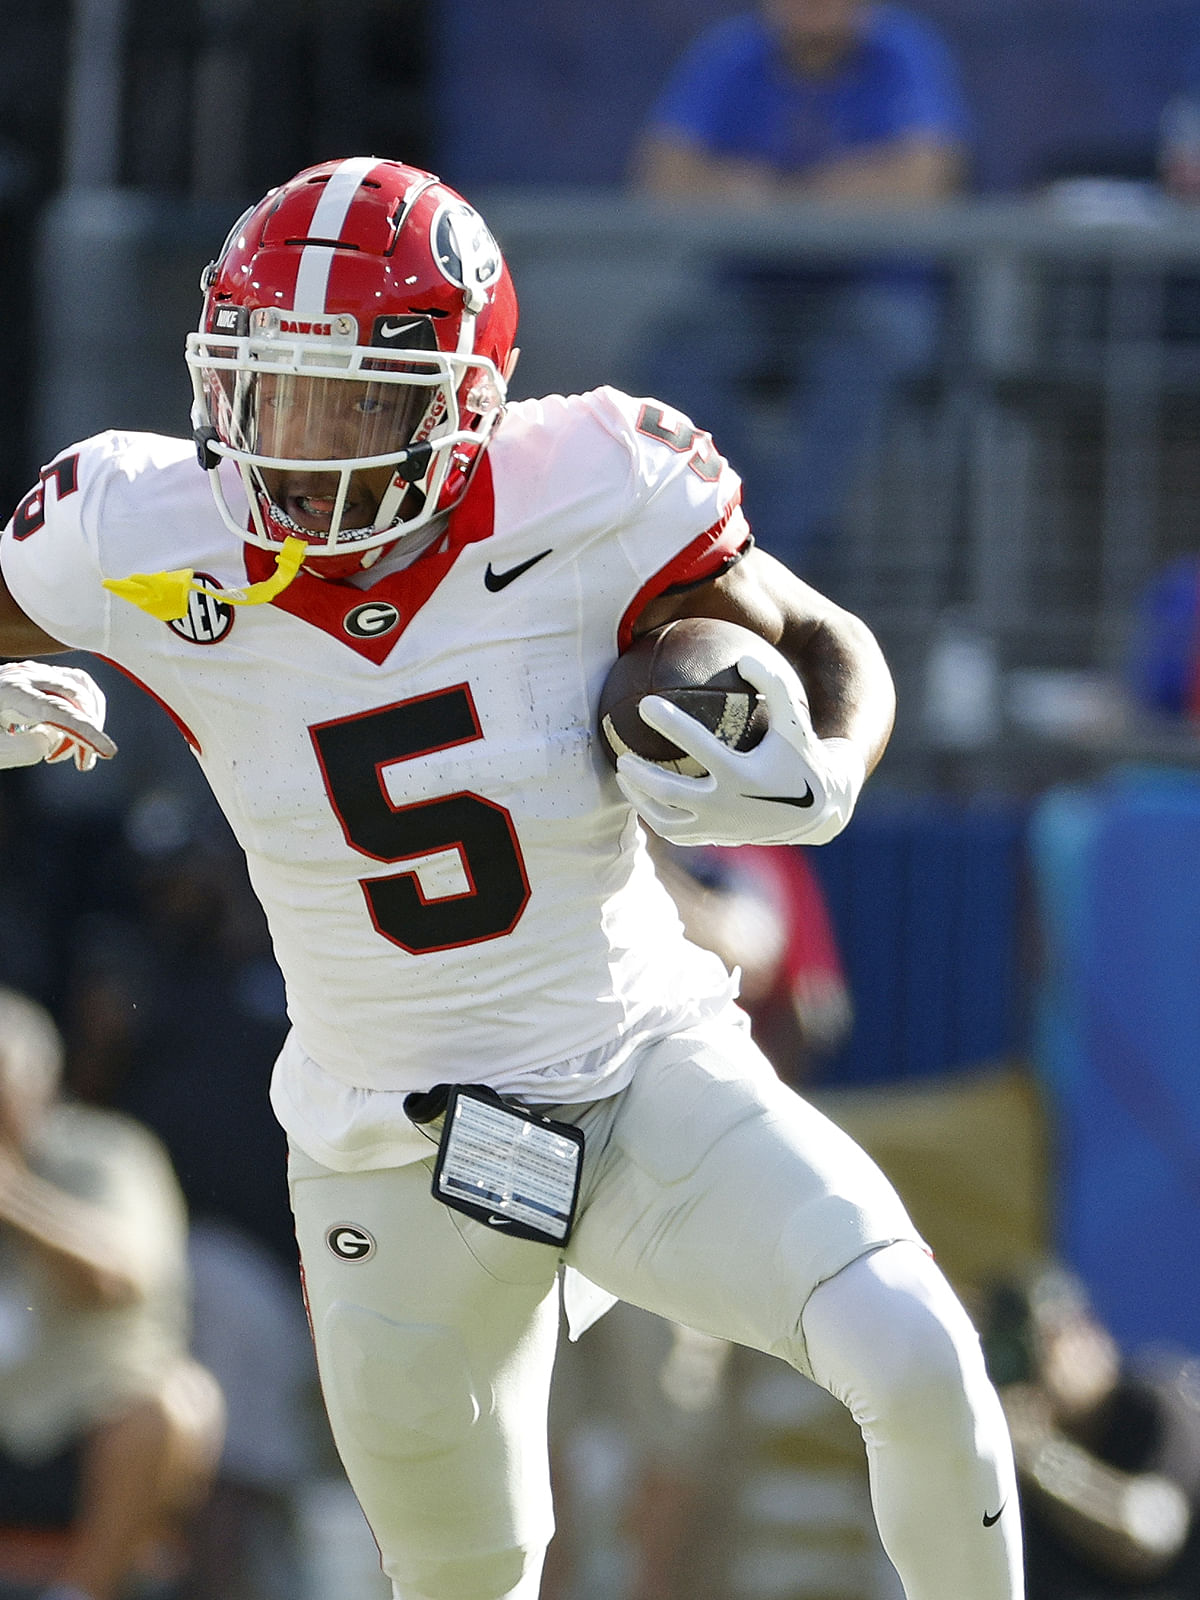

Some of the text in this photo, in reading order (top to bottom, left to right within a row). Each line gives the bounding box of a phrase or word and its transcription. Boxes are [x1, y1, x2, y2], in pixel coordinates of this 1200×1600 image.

[216, 309, 239, 328] NIKE
[279, 319, 332, 336] DAWGS
[636, 403, 723, 483] 5
[350, 605, 397, 634] G
[308, 681, 532, 956] 5
[331, 1228, 371, 1258] G
